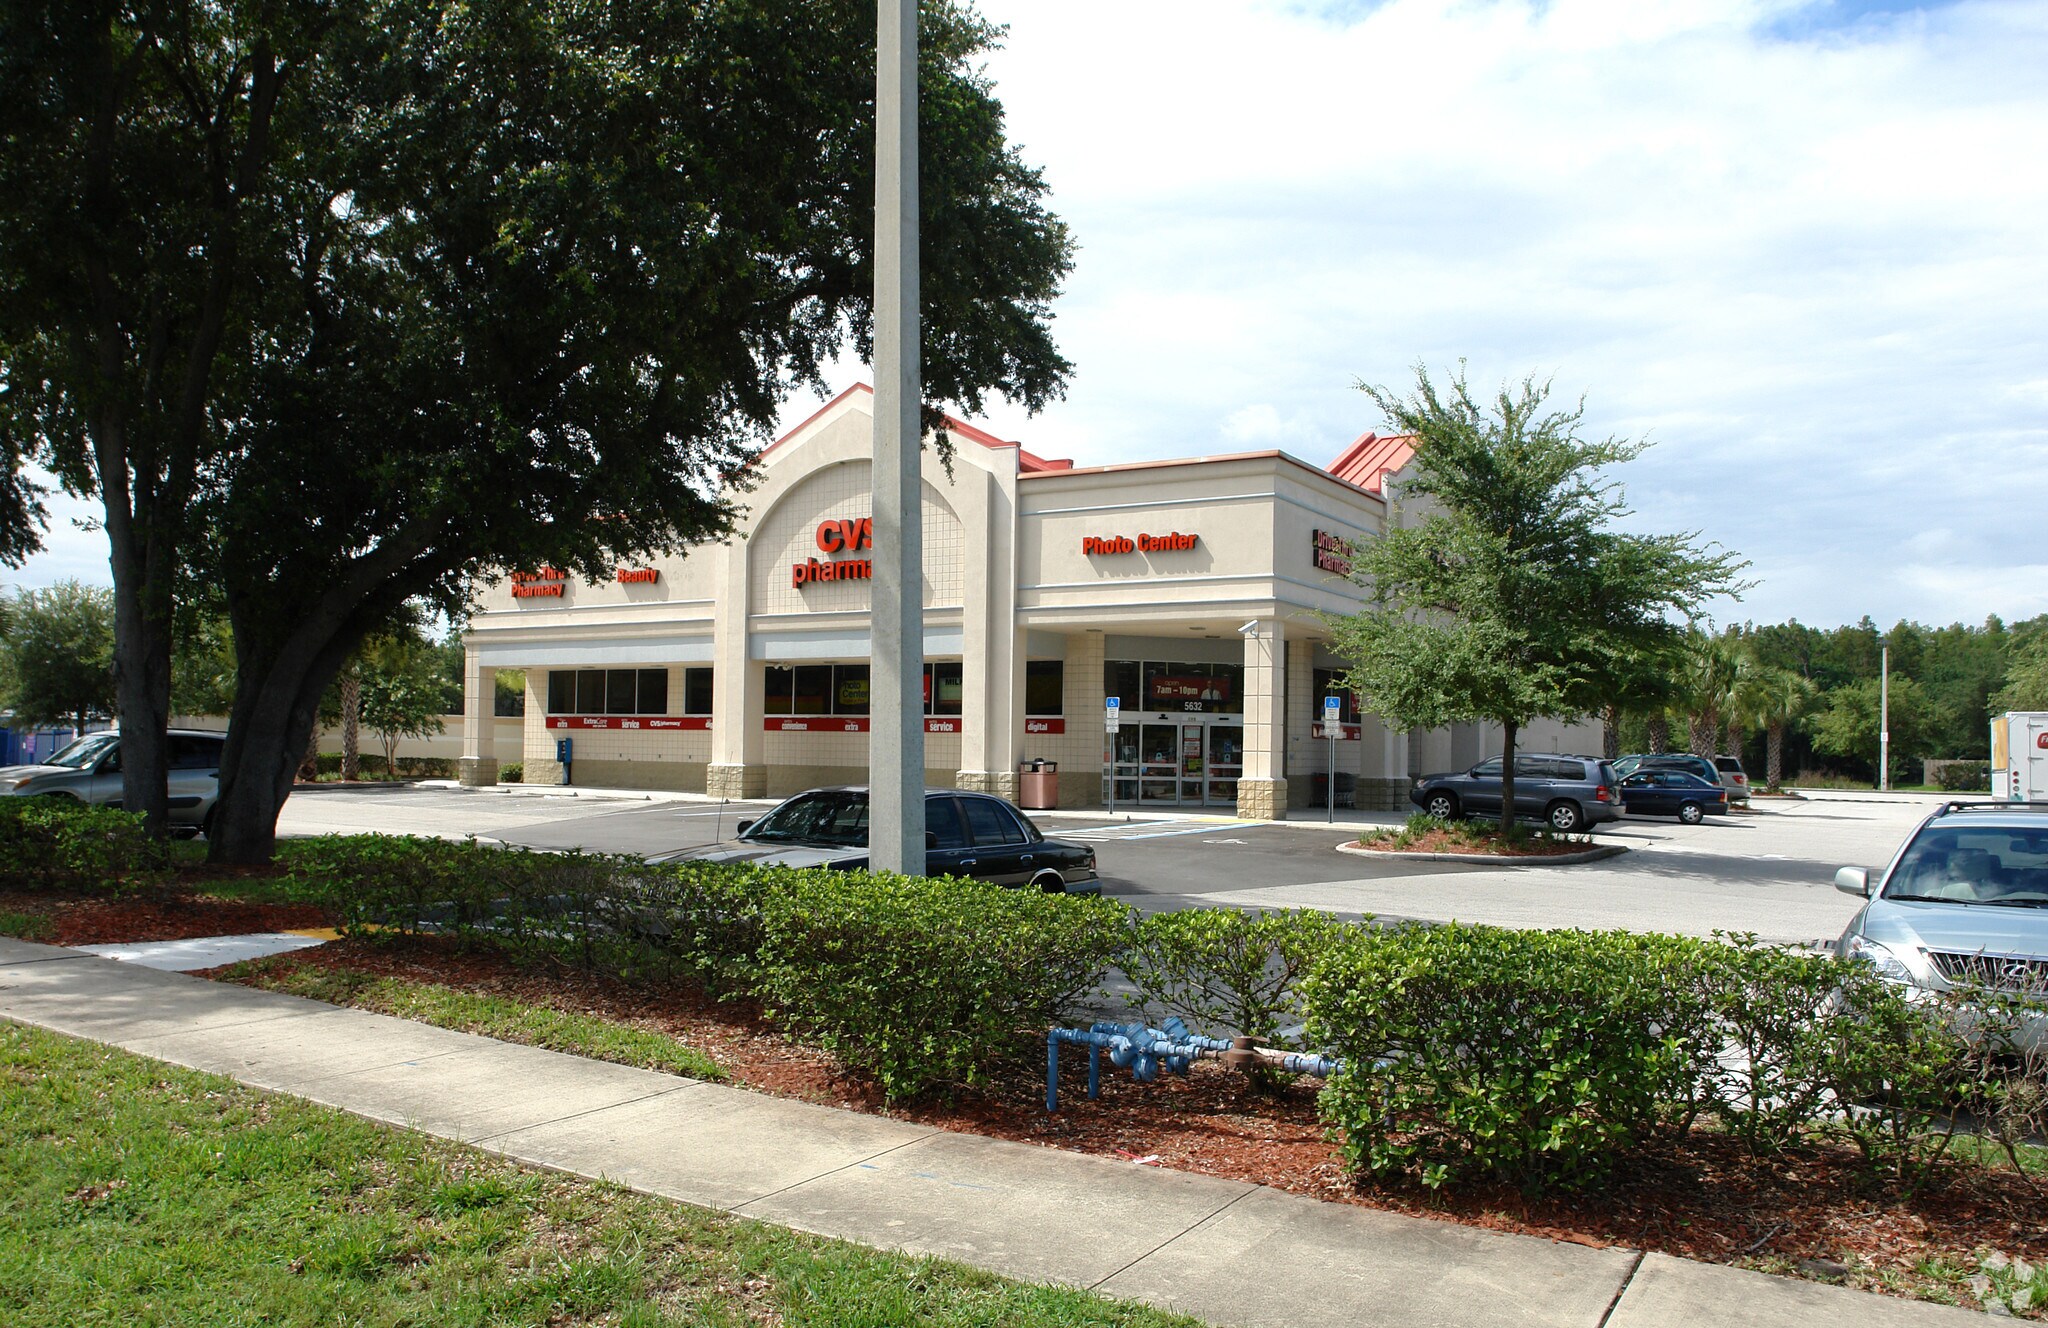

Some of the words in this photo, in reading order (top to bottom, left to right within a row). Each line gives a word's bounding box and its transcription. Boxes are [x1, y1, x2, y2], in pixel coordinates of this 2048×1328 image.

[1082, 535, 1135, 555] Photo
[1137, 531, 1199, 552] Center
[617, 566, 659, 584] Beauty
[511, 583, 565, 598] Pharmacy
[1156, 685, 1172, 694] 7am
[1179, 686, 1198, 696] 10pm
[1184, 701, 1203, 711] 5632
[929, 721, 954, 732] service
[1027, 722, 1048, 733] digital
